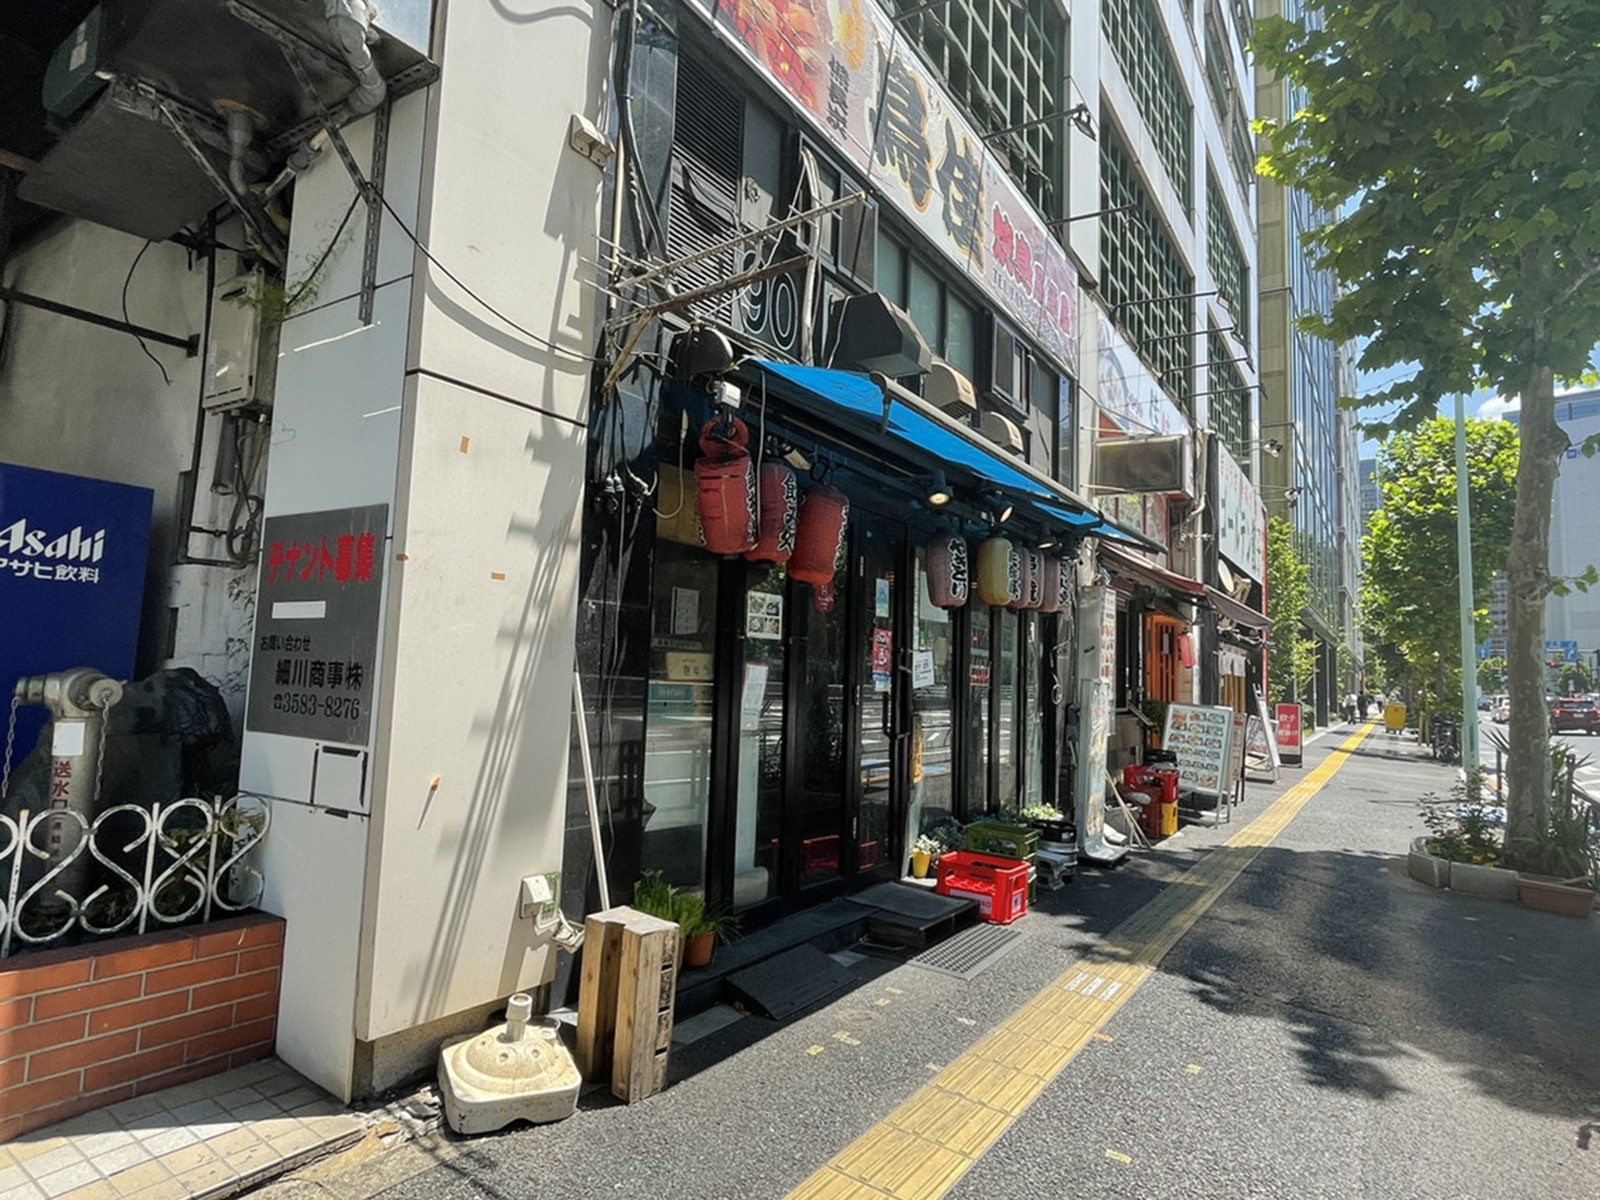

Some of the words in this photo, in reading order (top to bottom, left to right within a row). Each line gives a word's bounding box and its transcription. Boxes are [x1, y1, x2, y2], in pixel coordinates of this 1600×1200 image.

[0, 518, 105, 562] Asahi
[267, 532, 375, 585] テナント募集
[260, 634, 311, 652] お問い合わせ
[52, 760, 72, 820] 送水口
